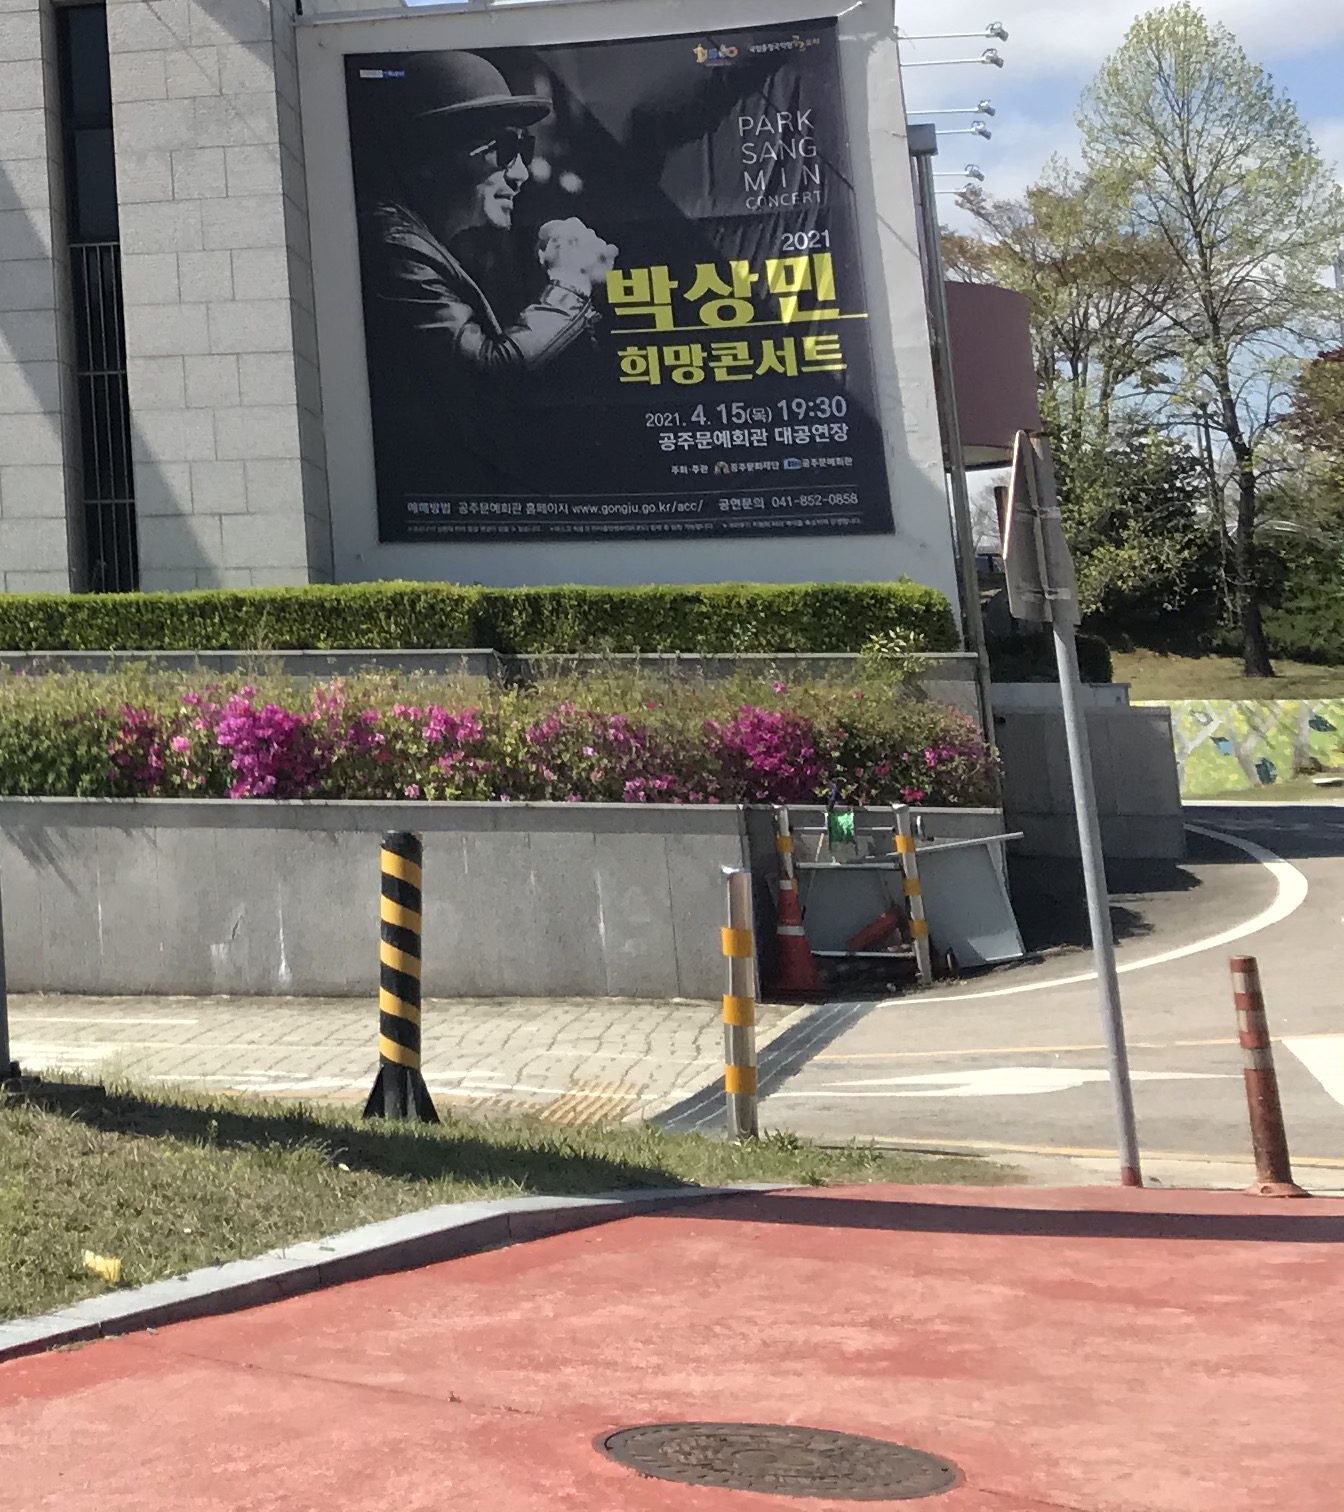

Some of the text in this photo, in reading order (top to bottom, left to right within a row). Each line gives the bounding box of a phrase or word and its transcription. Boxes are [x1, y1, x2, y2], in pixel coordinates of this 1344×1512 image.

[738, 108, 815, 137] PARK
[741, 136, 817, 165] SANG
[745, 190, 821, 211] CONCERT
[781, 229, 830, 251] 2021
[605, 252, 840, 331] 박상민
[618, 334, 847, 385] 희망콘서트
[777, 395, 847, 420] 19:30
[659, 423, 849, 452] 공주문예회관 대공연장
[772, 493, 859, 508] 041-852-0858
